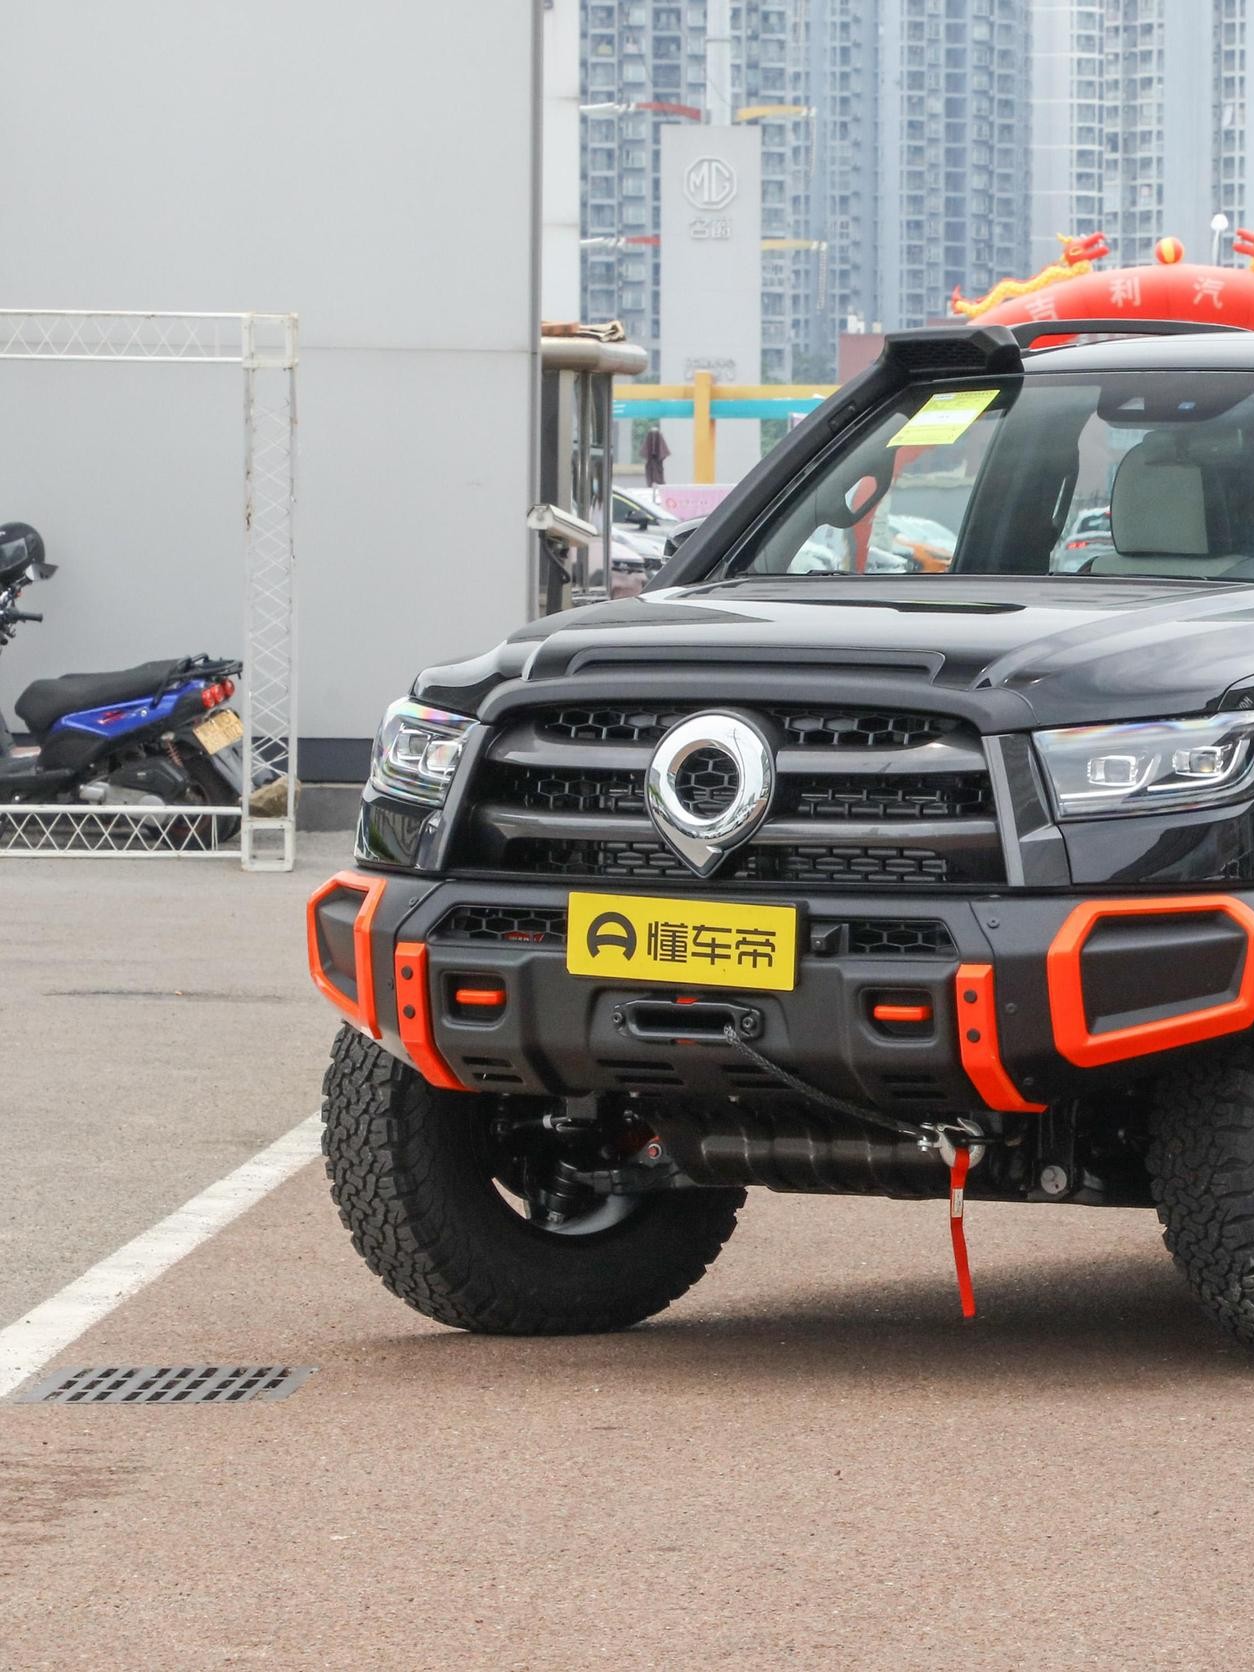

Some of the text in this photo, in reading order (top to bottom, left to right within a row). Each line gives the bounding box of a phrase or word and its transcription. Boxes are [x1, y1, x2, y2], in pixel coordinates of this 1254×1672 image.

[688, 159, 732, 204] MG
[647, 921, 777, 969] 懂车帝
